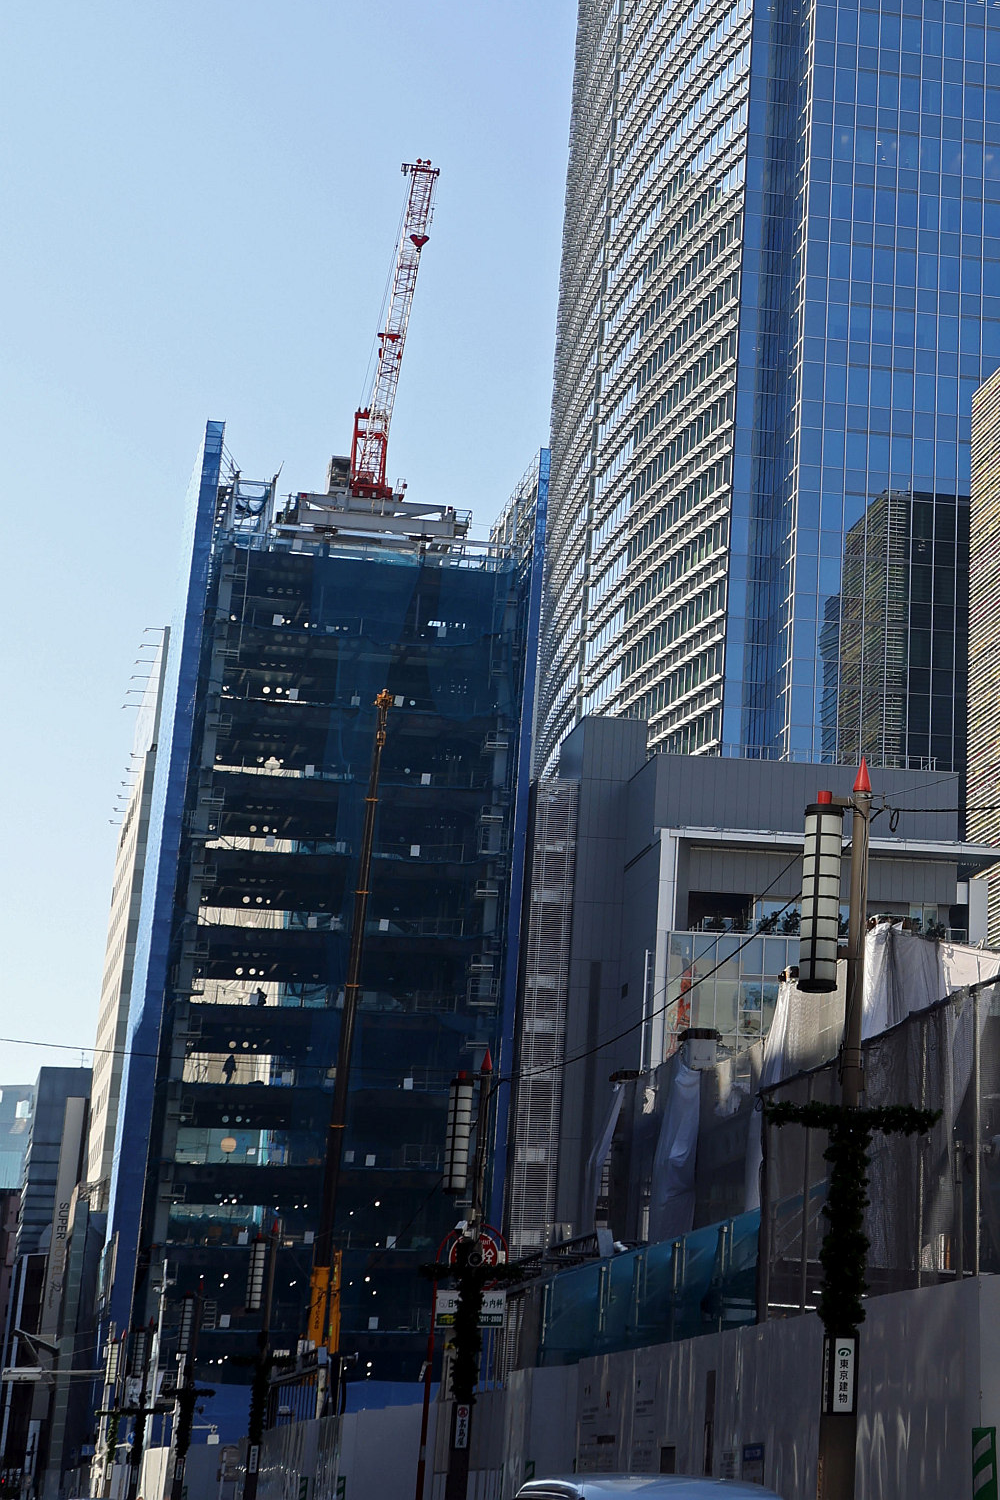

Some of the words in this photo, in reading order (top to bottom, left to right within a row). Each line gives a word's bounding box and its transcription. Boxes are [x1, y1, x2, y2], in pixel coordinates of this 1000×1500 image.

[56, 1202, 69, 1240] SUPER
[51, 1240, 65, 1279] HOTEL
[838, 1359, 849, 1404] 東京建物
